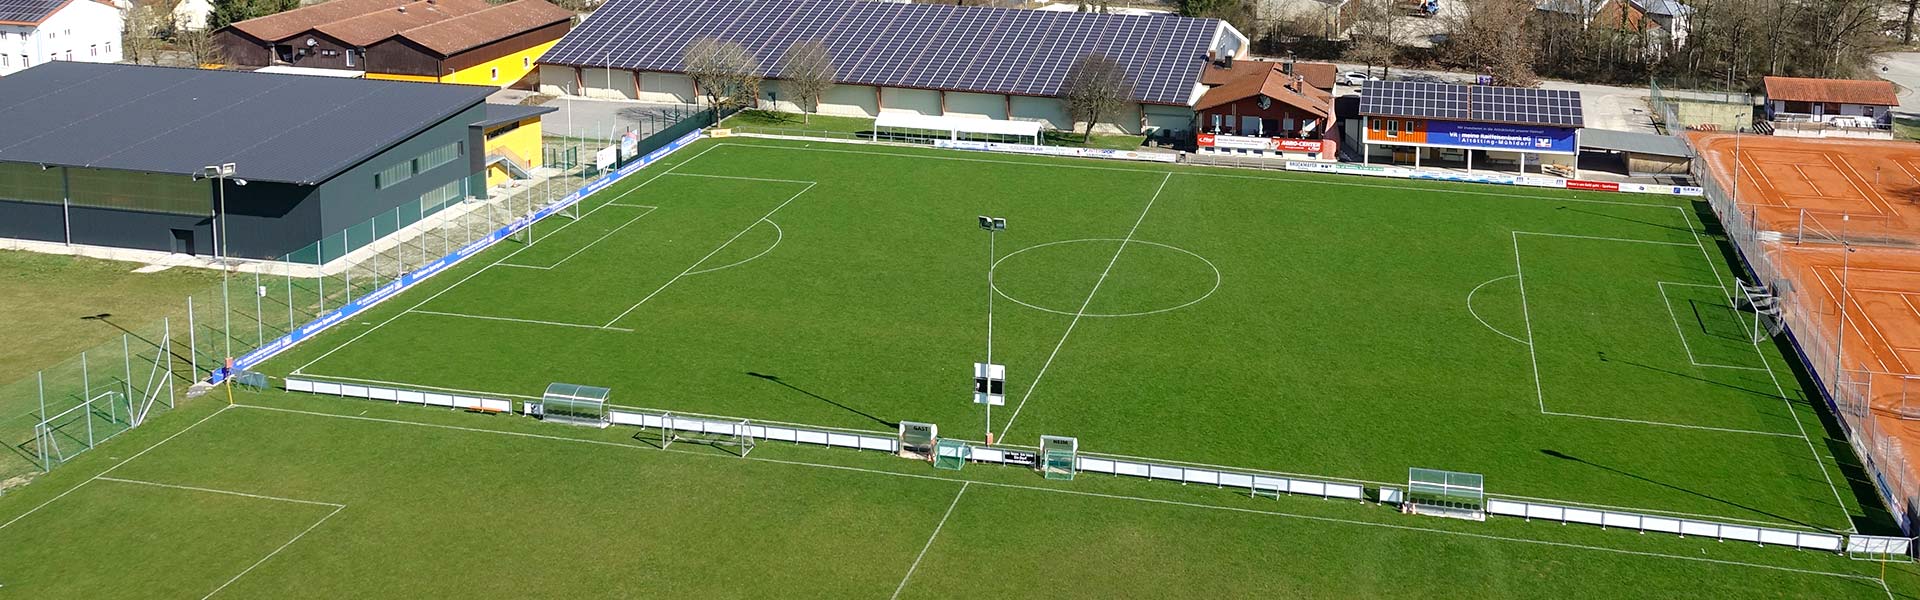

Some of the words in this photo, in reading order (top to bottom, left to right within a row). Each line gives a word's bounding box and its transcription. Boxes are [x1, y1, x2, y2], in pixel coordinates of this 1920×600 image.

[1280, 139, 1322, 149] AGRO-CENTER
[913, 425, 929, 433] GAST
[1053, 438, 1069, 446] HEIM
